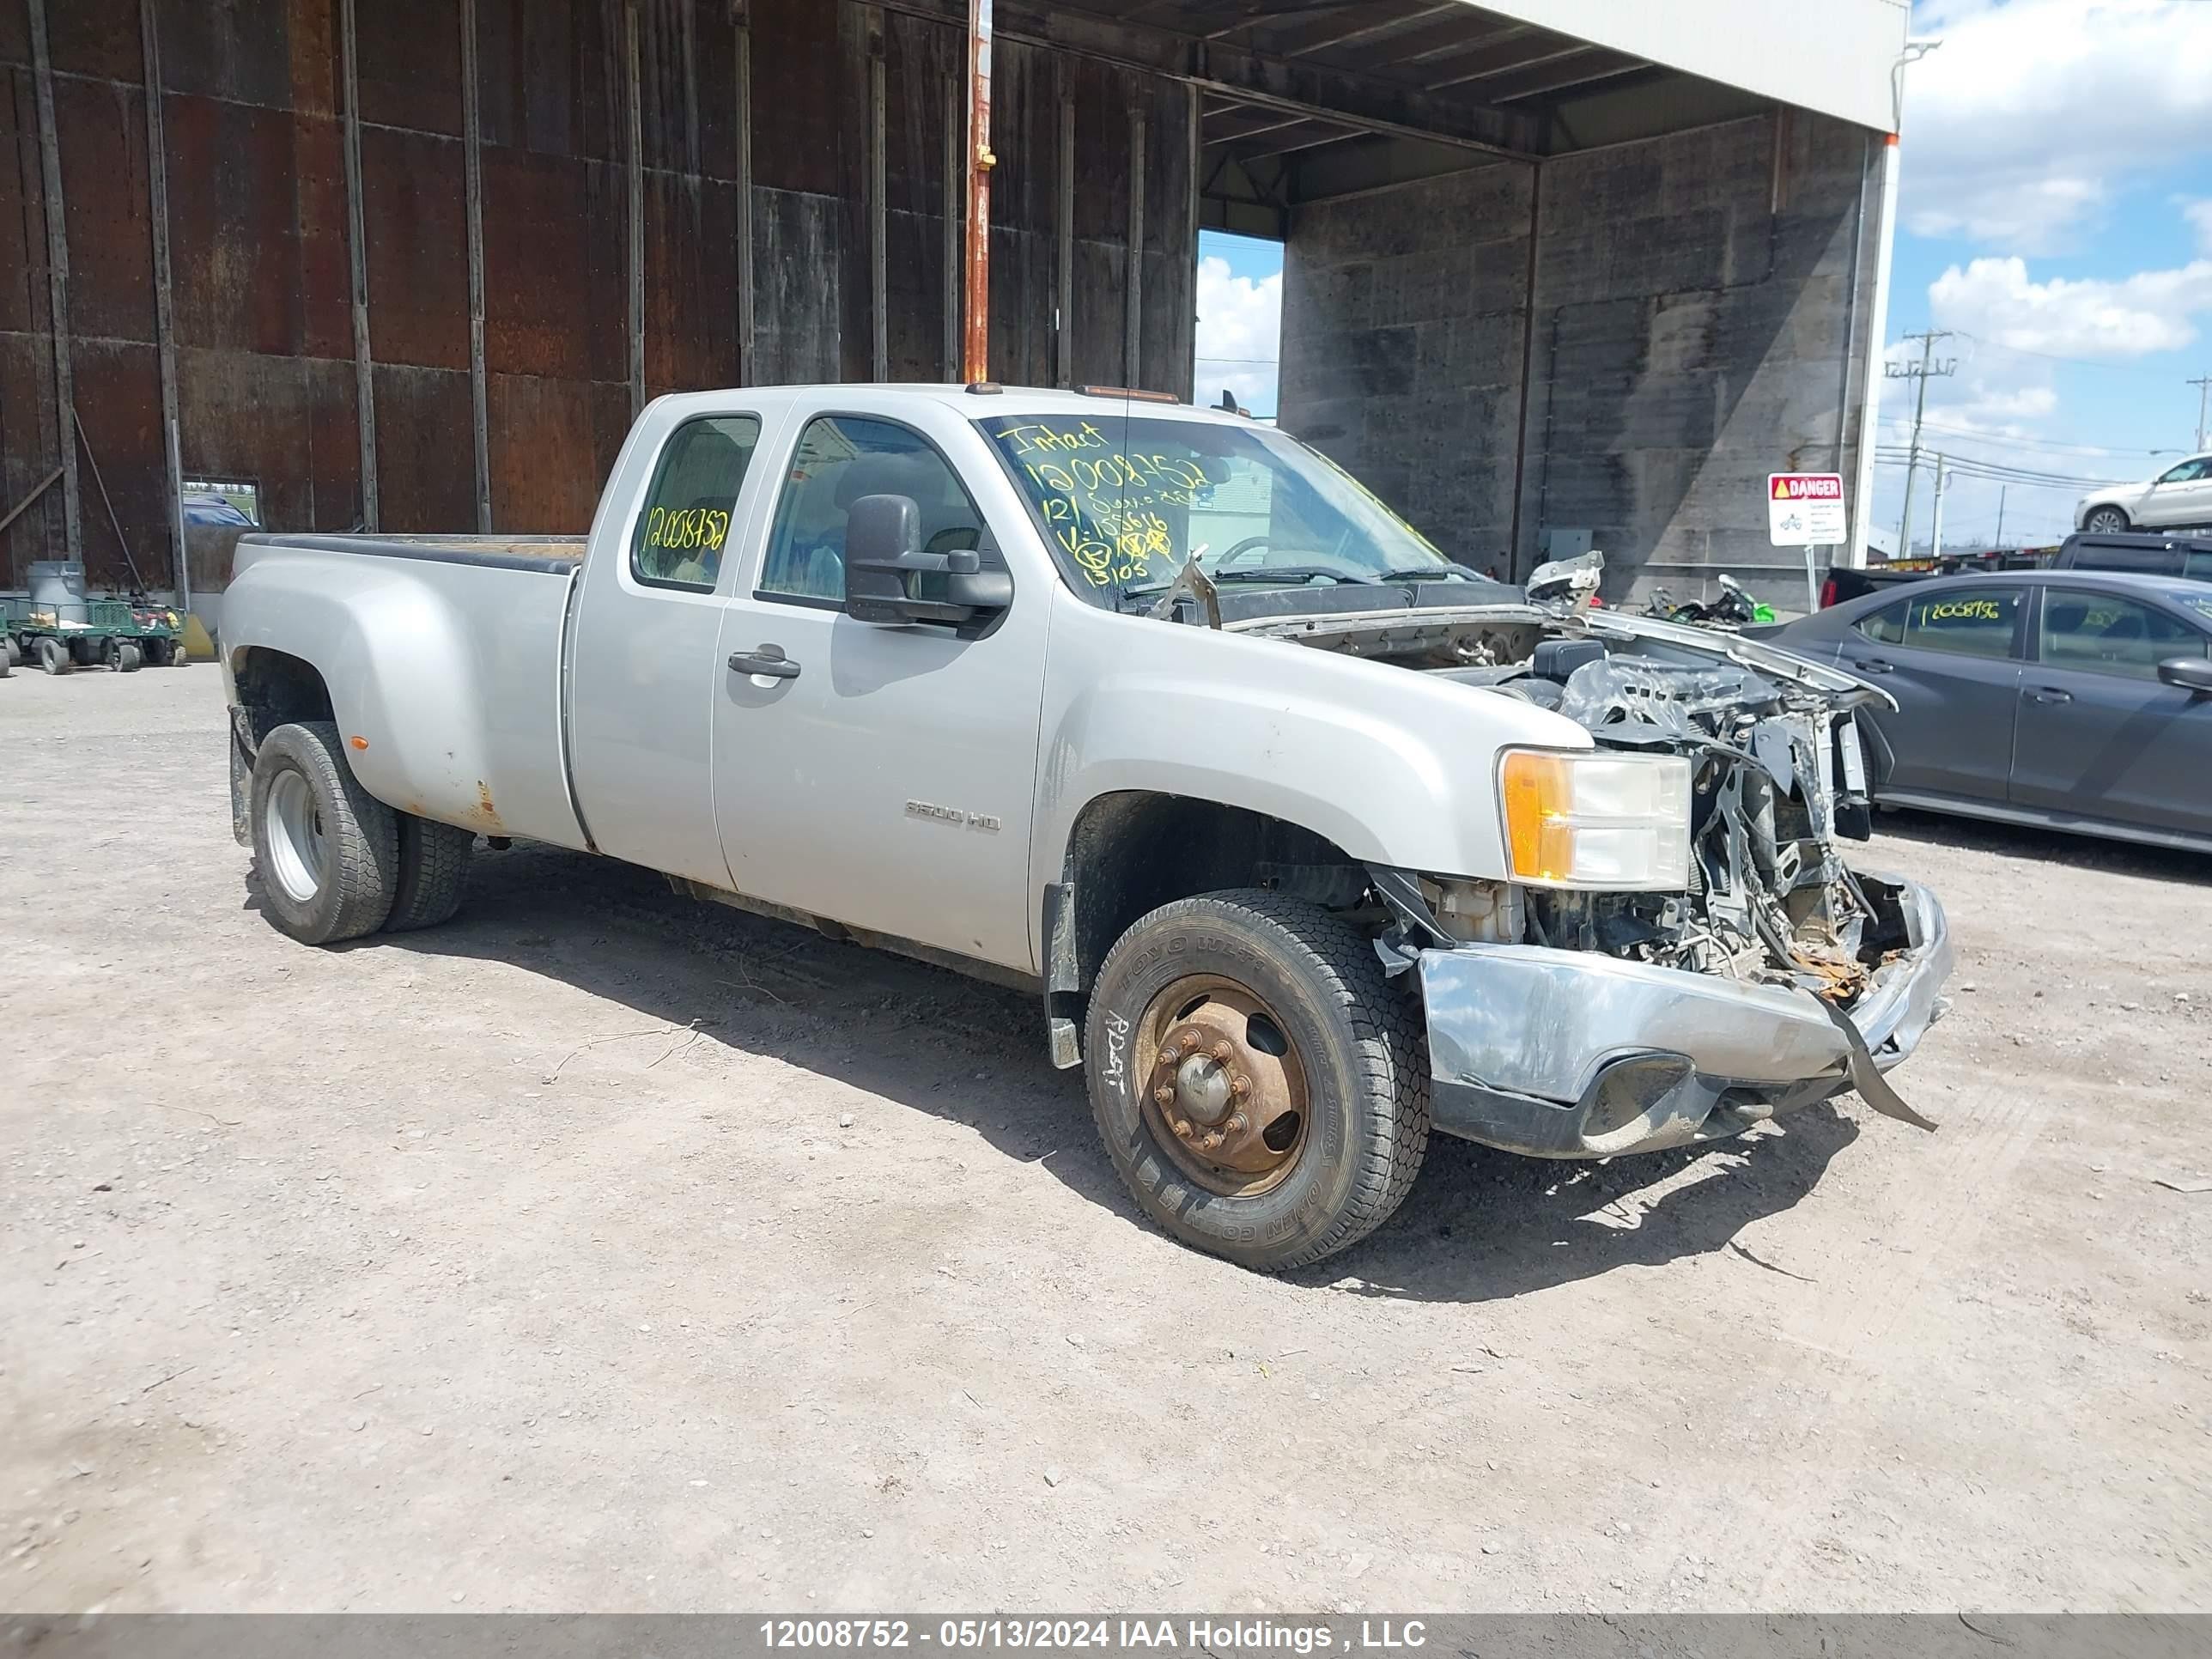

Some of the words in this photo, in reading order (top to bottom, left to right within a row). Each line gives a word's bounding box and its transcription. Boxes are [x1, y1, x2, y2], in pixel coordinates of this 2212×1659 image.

[996, 421, 1109, 455] Intact
[1024, 454, 1212, 492] 12008752
[1790, 480, 1839, 496] DANGER
[642, 507, 728, 550] 12008752
[968, 811, 1001, 831] HD
[1116, 936, 1188, 992] TOYO
[1265, 1180, 1322, 1237] OPEN
